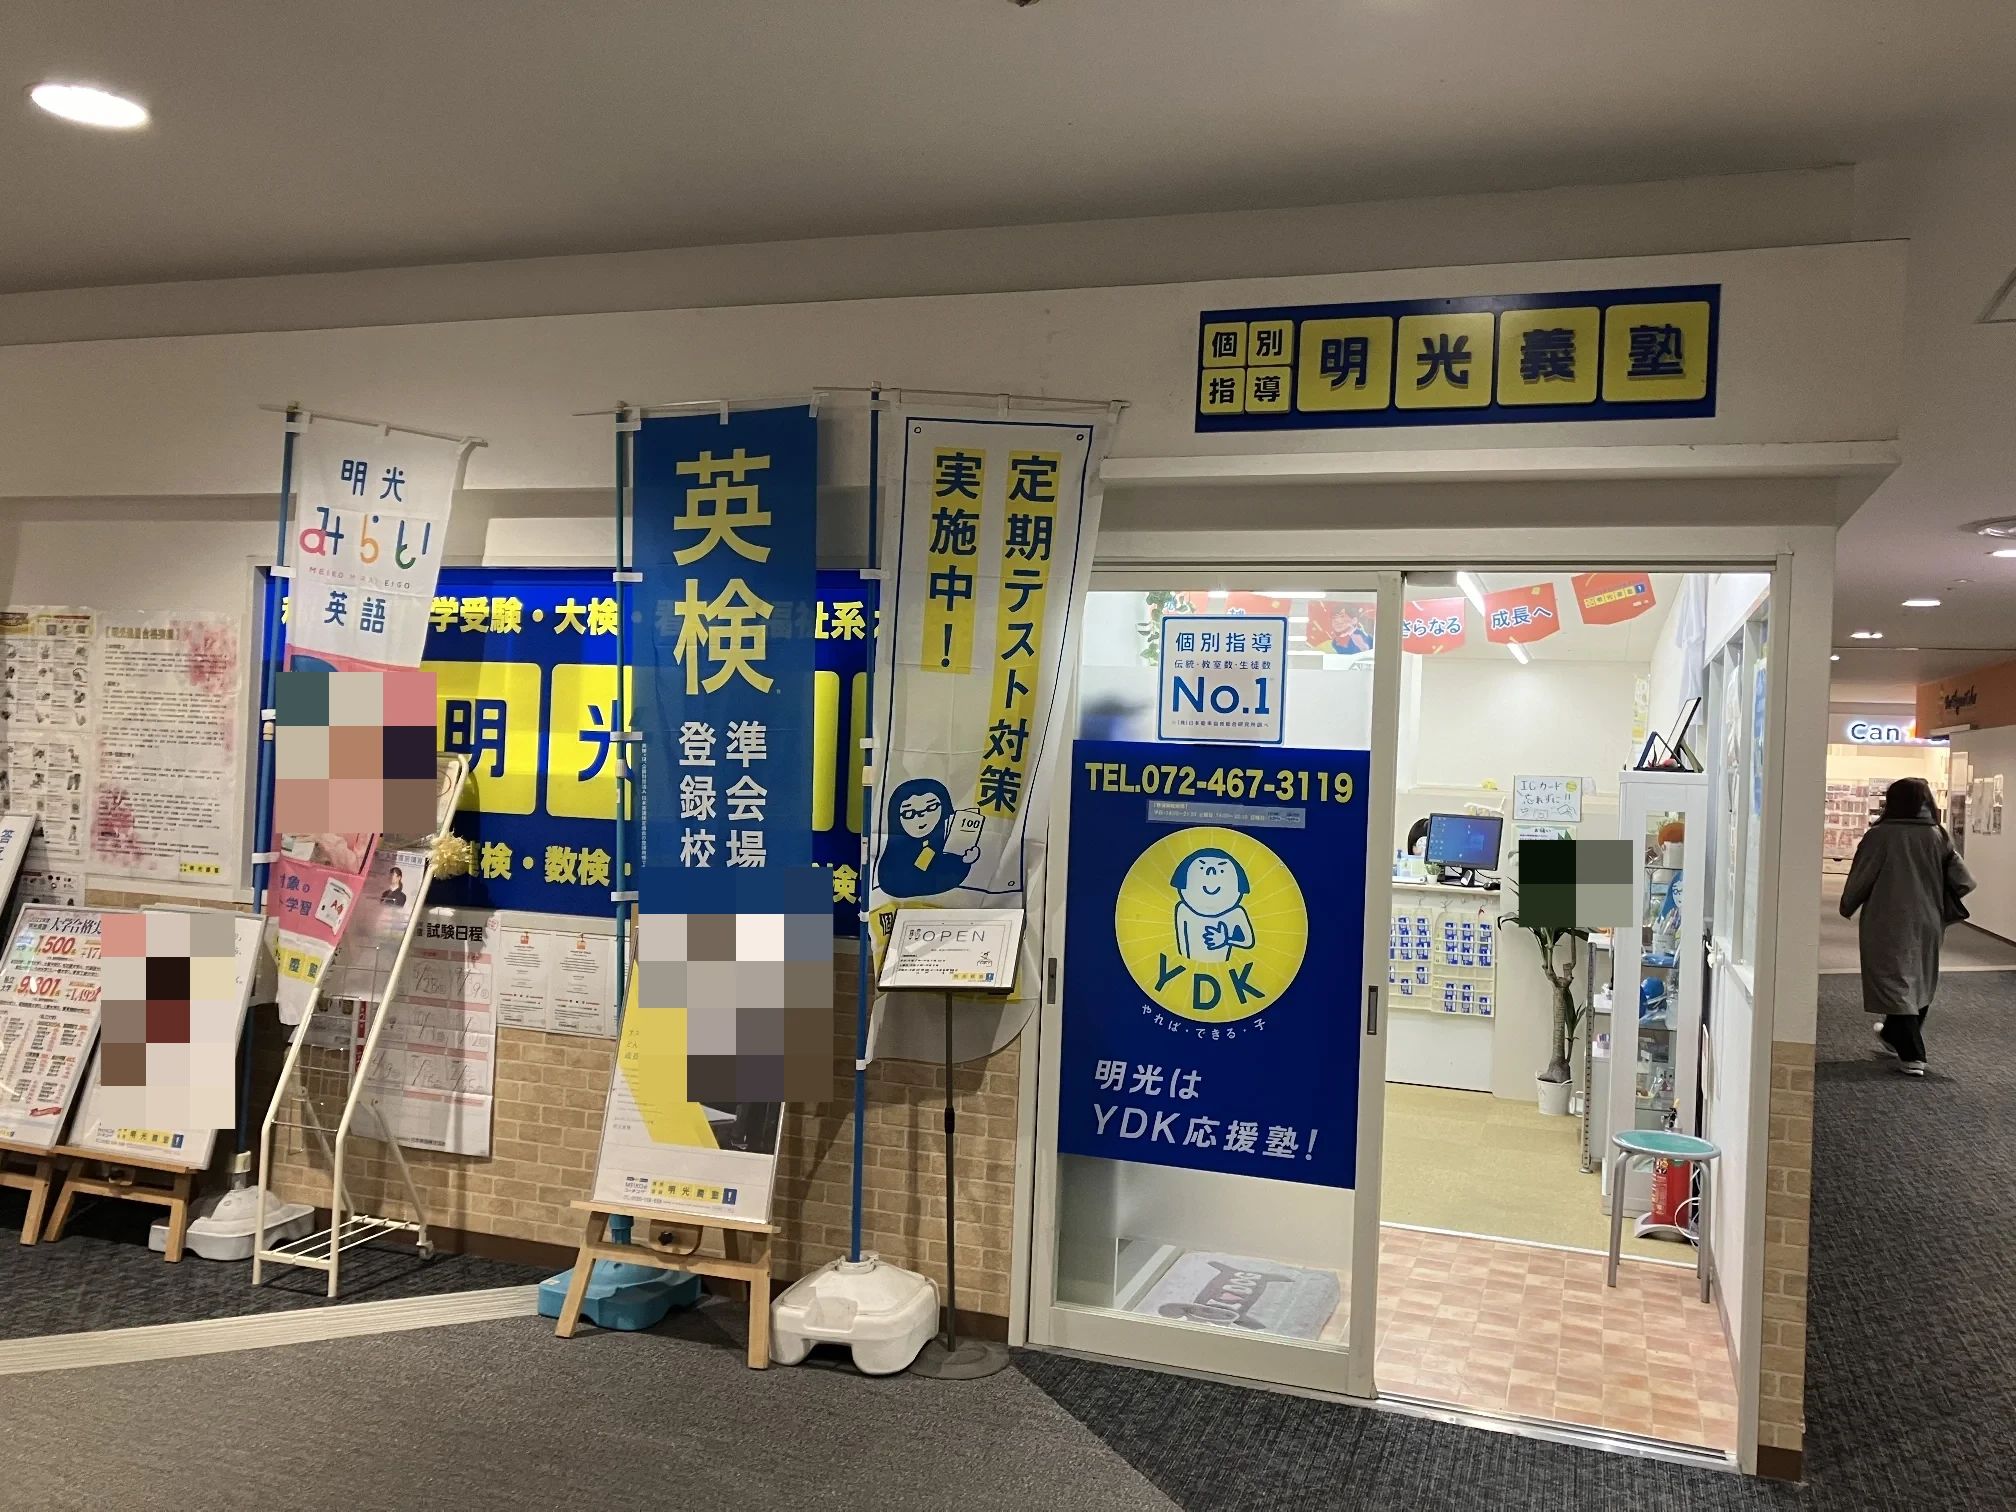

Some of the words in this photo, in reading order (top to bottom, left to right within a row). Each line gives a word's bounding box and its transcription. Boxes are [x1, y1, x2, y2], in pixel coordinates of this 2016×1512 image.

[1211, 329, 1283, 358] 個別
[1320, 324, 1684, 390] 明光義塾
[1209, 375, 1281, 405] 指導
[341, 459, 406, 502] 明光
[300, 506, 431, 569] みらい
[309, 566, 344, 579] MEIKO
[384, 579, 411, 589] EIGO
[673, 448, 774, 695] 英検
[929, 451, 982, 668] 実施中!
[324, 590, 386, 634] 英語
[1490, 604, 1552, 629] 成長へ
[976, 454, 1058, 813] 定期テスト対策
[1175, 632, 1273, 653] 個別指導
[1174, 659, 1271, 670] 伝統・教室数・生徒数
[1172, 676, 1270, 715] No.1
[679, 721, 717, 868] 登録校
[726, 720, 768, 868] 準会場
[1084, 762, 1353, 803] TEL.072-467-3119
[960, 817, 981, 830] 100
[279, 894, 312, 917] 学習
[426, 923, 483, 942] 試験日程
[922, 929, 986, 943] OPEN
[1153, 952, 1266, 1011] YDK
[1141, 1003, 1266, 1041] やれば・できる・子
[1094, 1059, 1202, 1100] 明光は
[1092, 1103, 1320, 1161] YDK応援塾!
